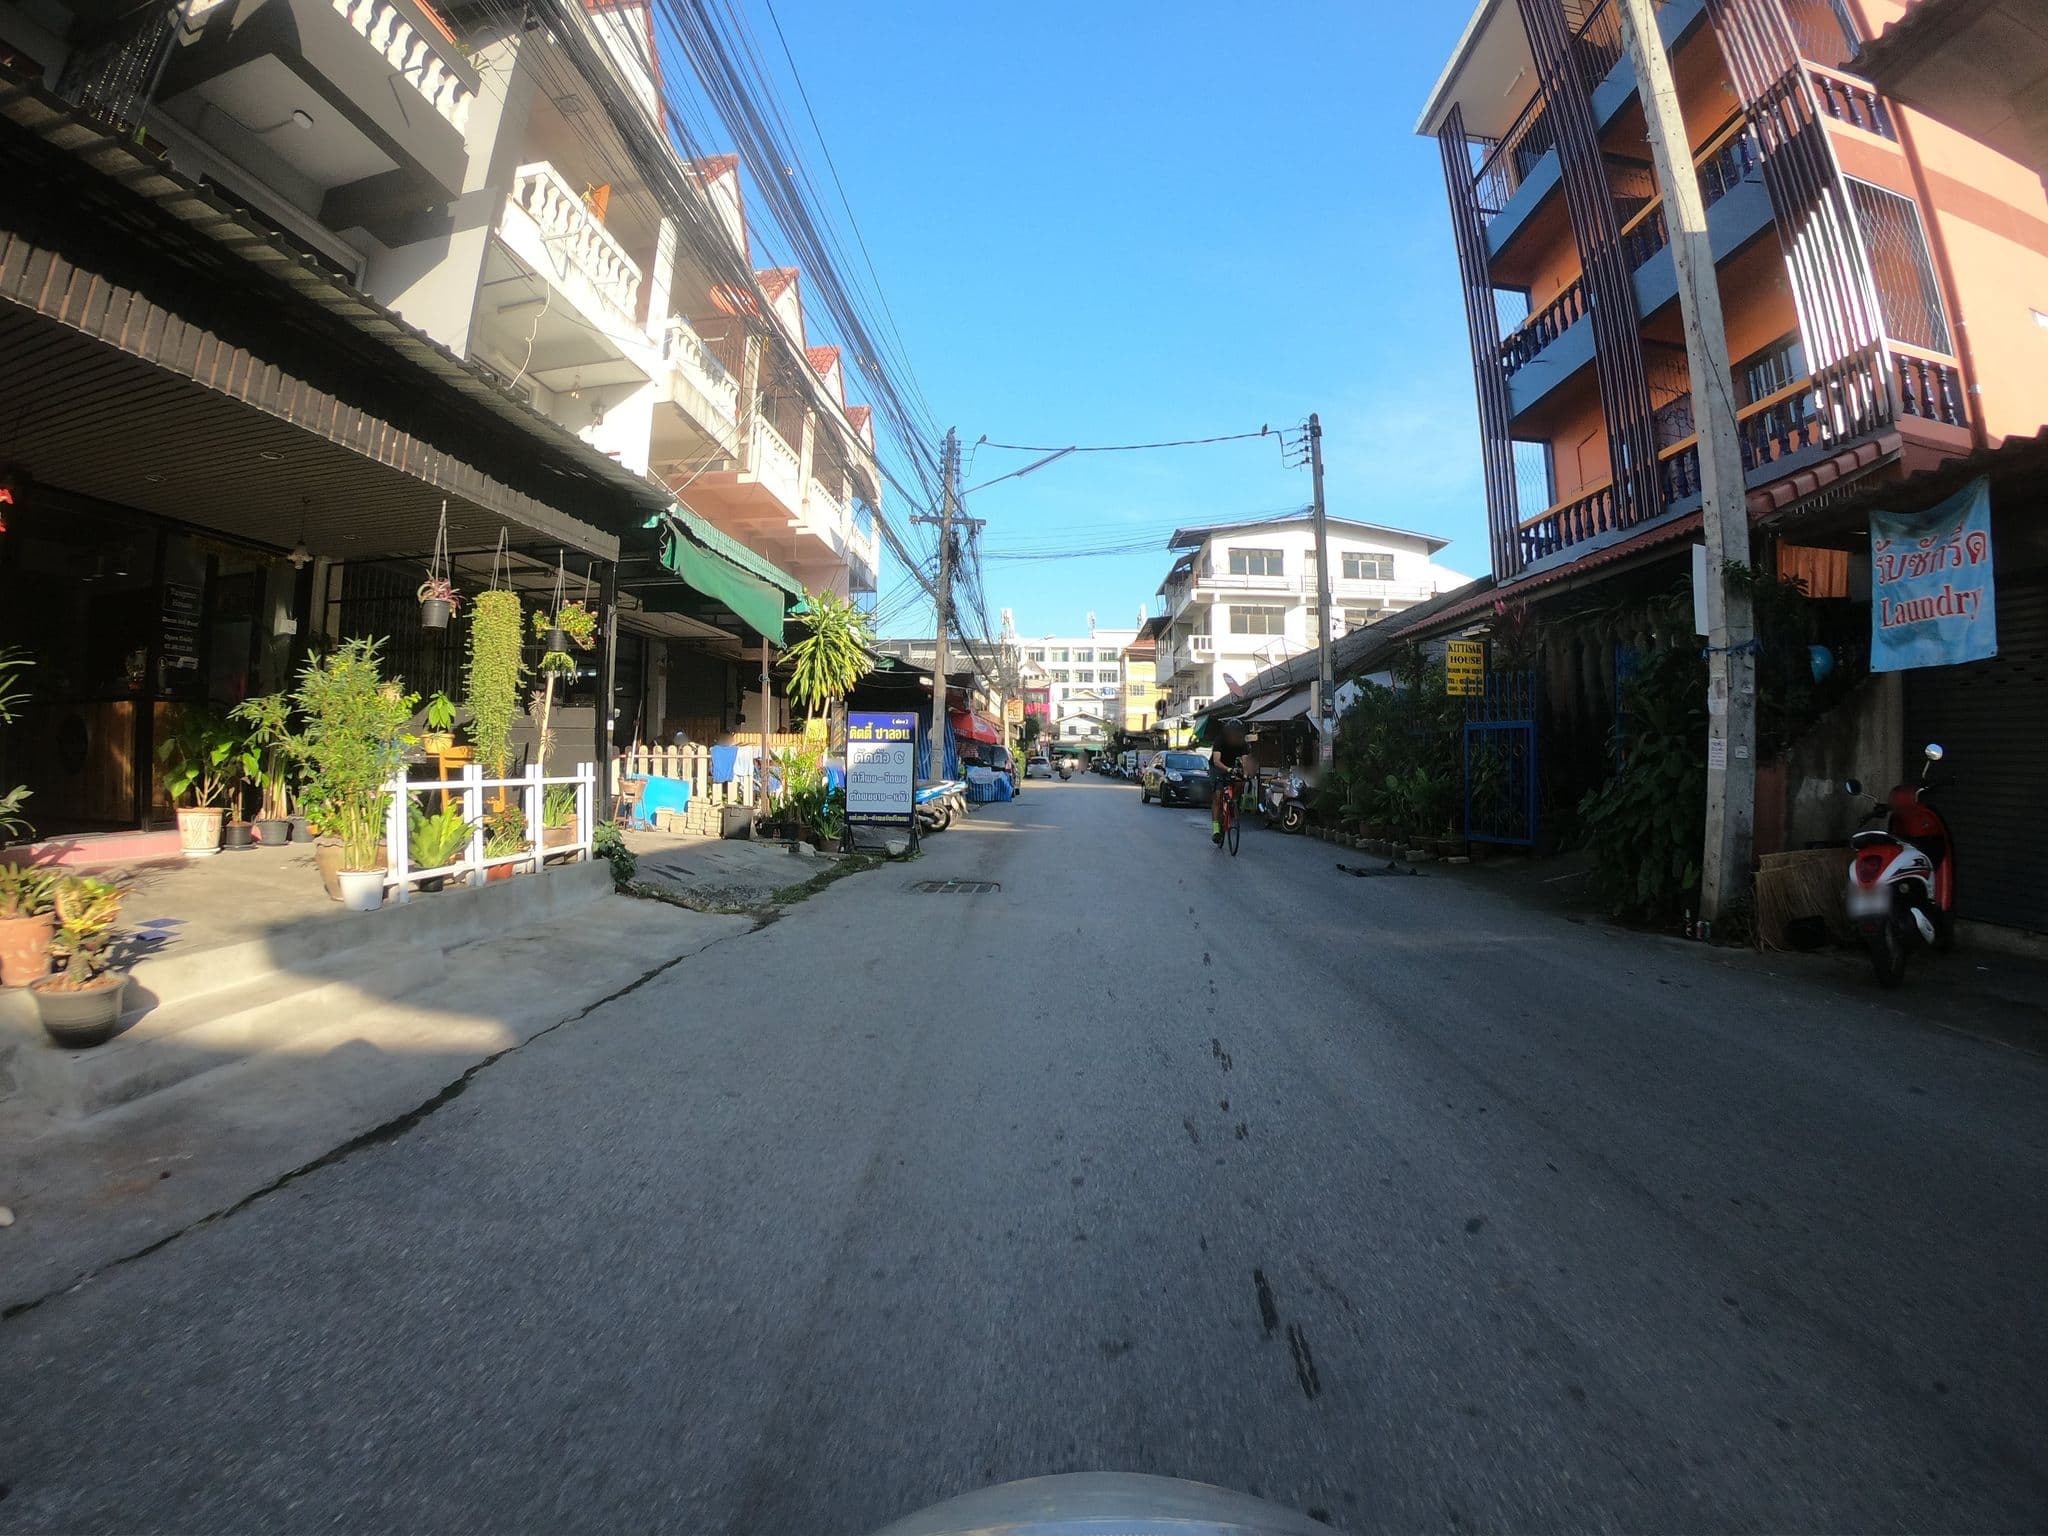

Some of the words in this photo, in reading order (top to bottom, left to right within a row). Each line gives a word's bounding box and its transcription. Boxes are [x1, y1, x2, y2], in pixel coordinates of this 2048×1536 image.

[1875, 523, 1987, 584] รับซักรีด
[1881, 585, 1984, 627] Laundry
[1448, 642, 1481, 654] KITTISAK
[1450, 655, 1481, 665] HOUSE
